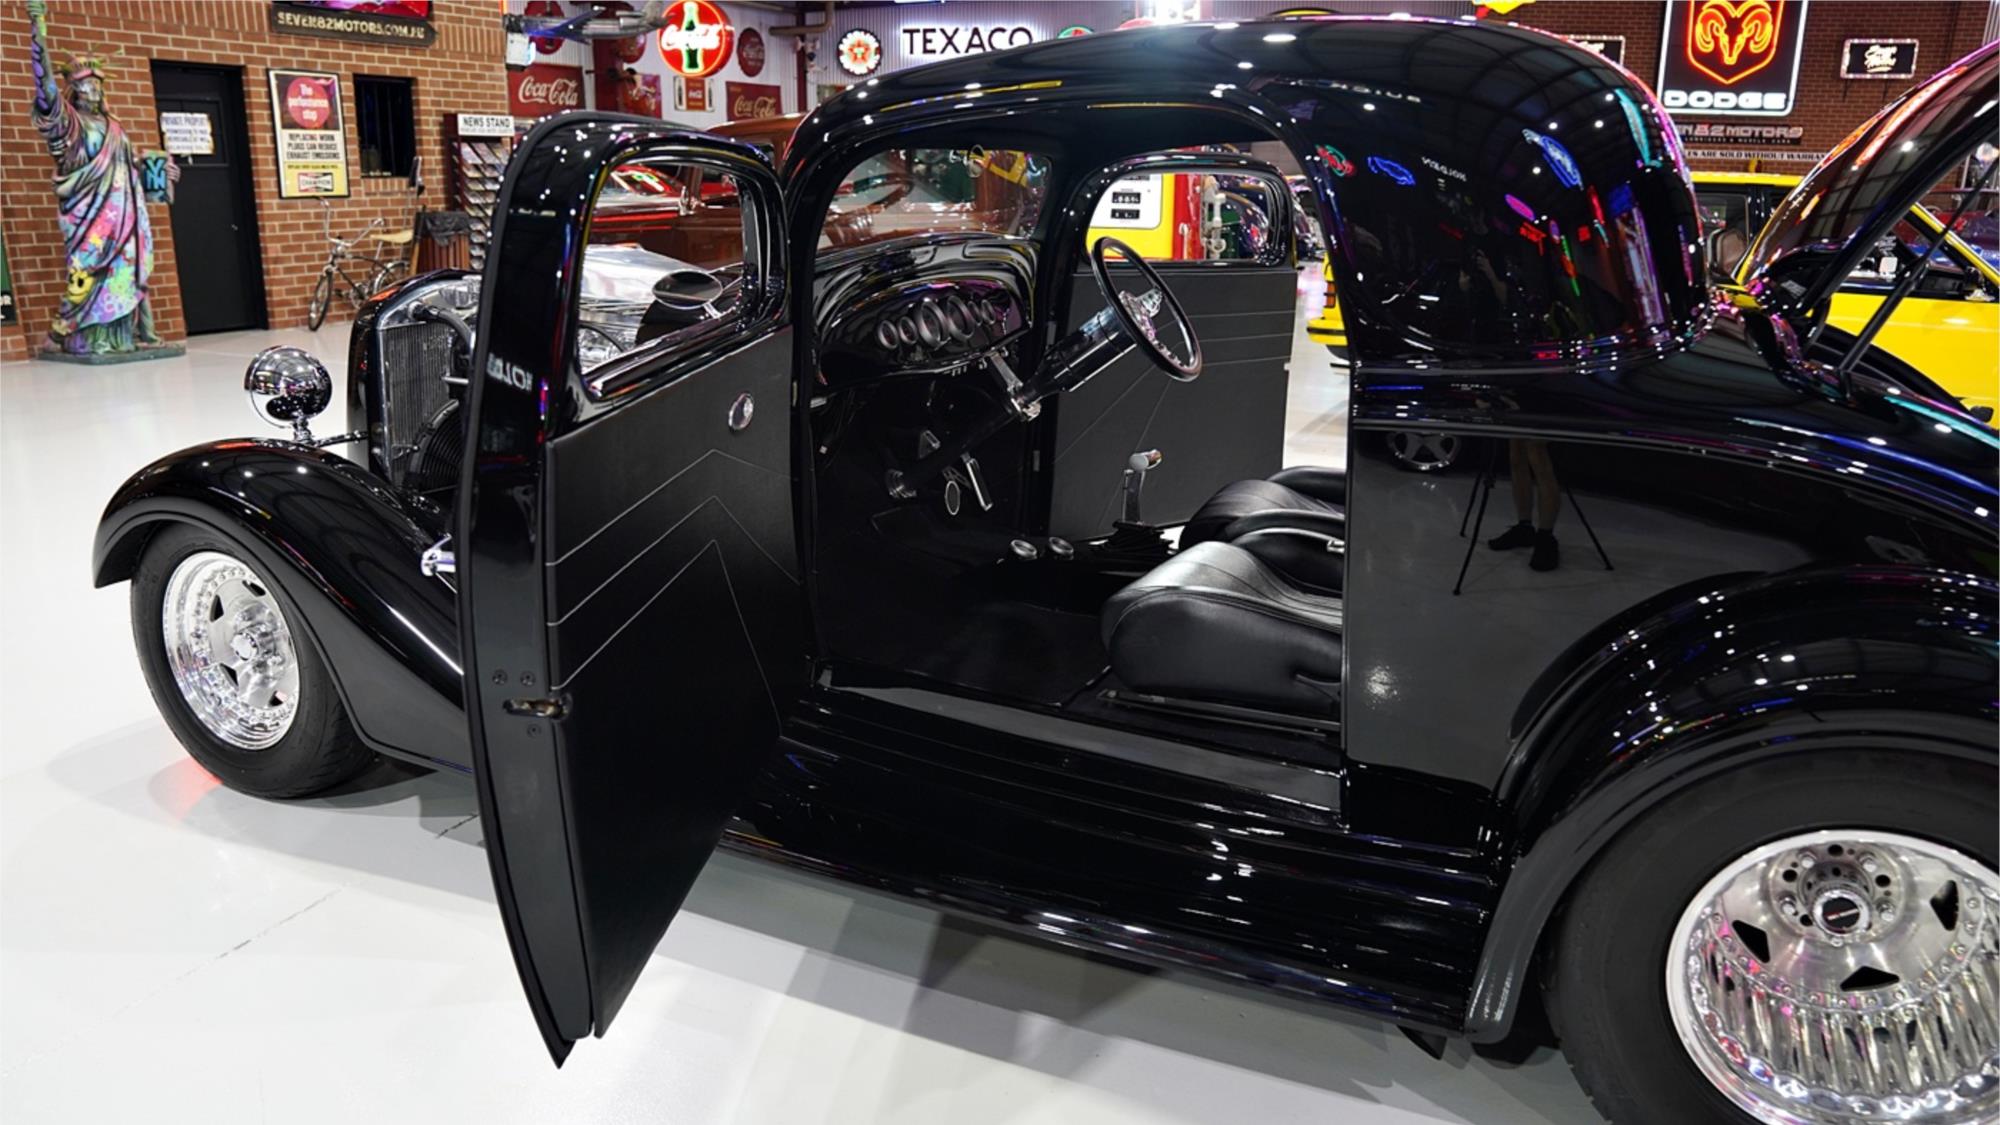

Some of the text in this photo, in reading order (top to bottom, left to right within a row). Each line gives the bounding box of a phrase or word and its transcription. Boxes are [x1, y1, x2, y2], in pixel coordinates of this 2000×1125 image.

[902, 27, 1032, 55] TEXACO
[518, 76, 579, 106] Coca-Cola
[1663, 90, 1787, 110] DODGE
[463, 116, 511, 129] NEWS STAND
[1726, 125, 1804, 139] MOTORS
